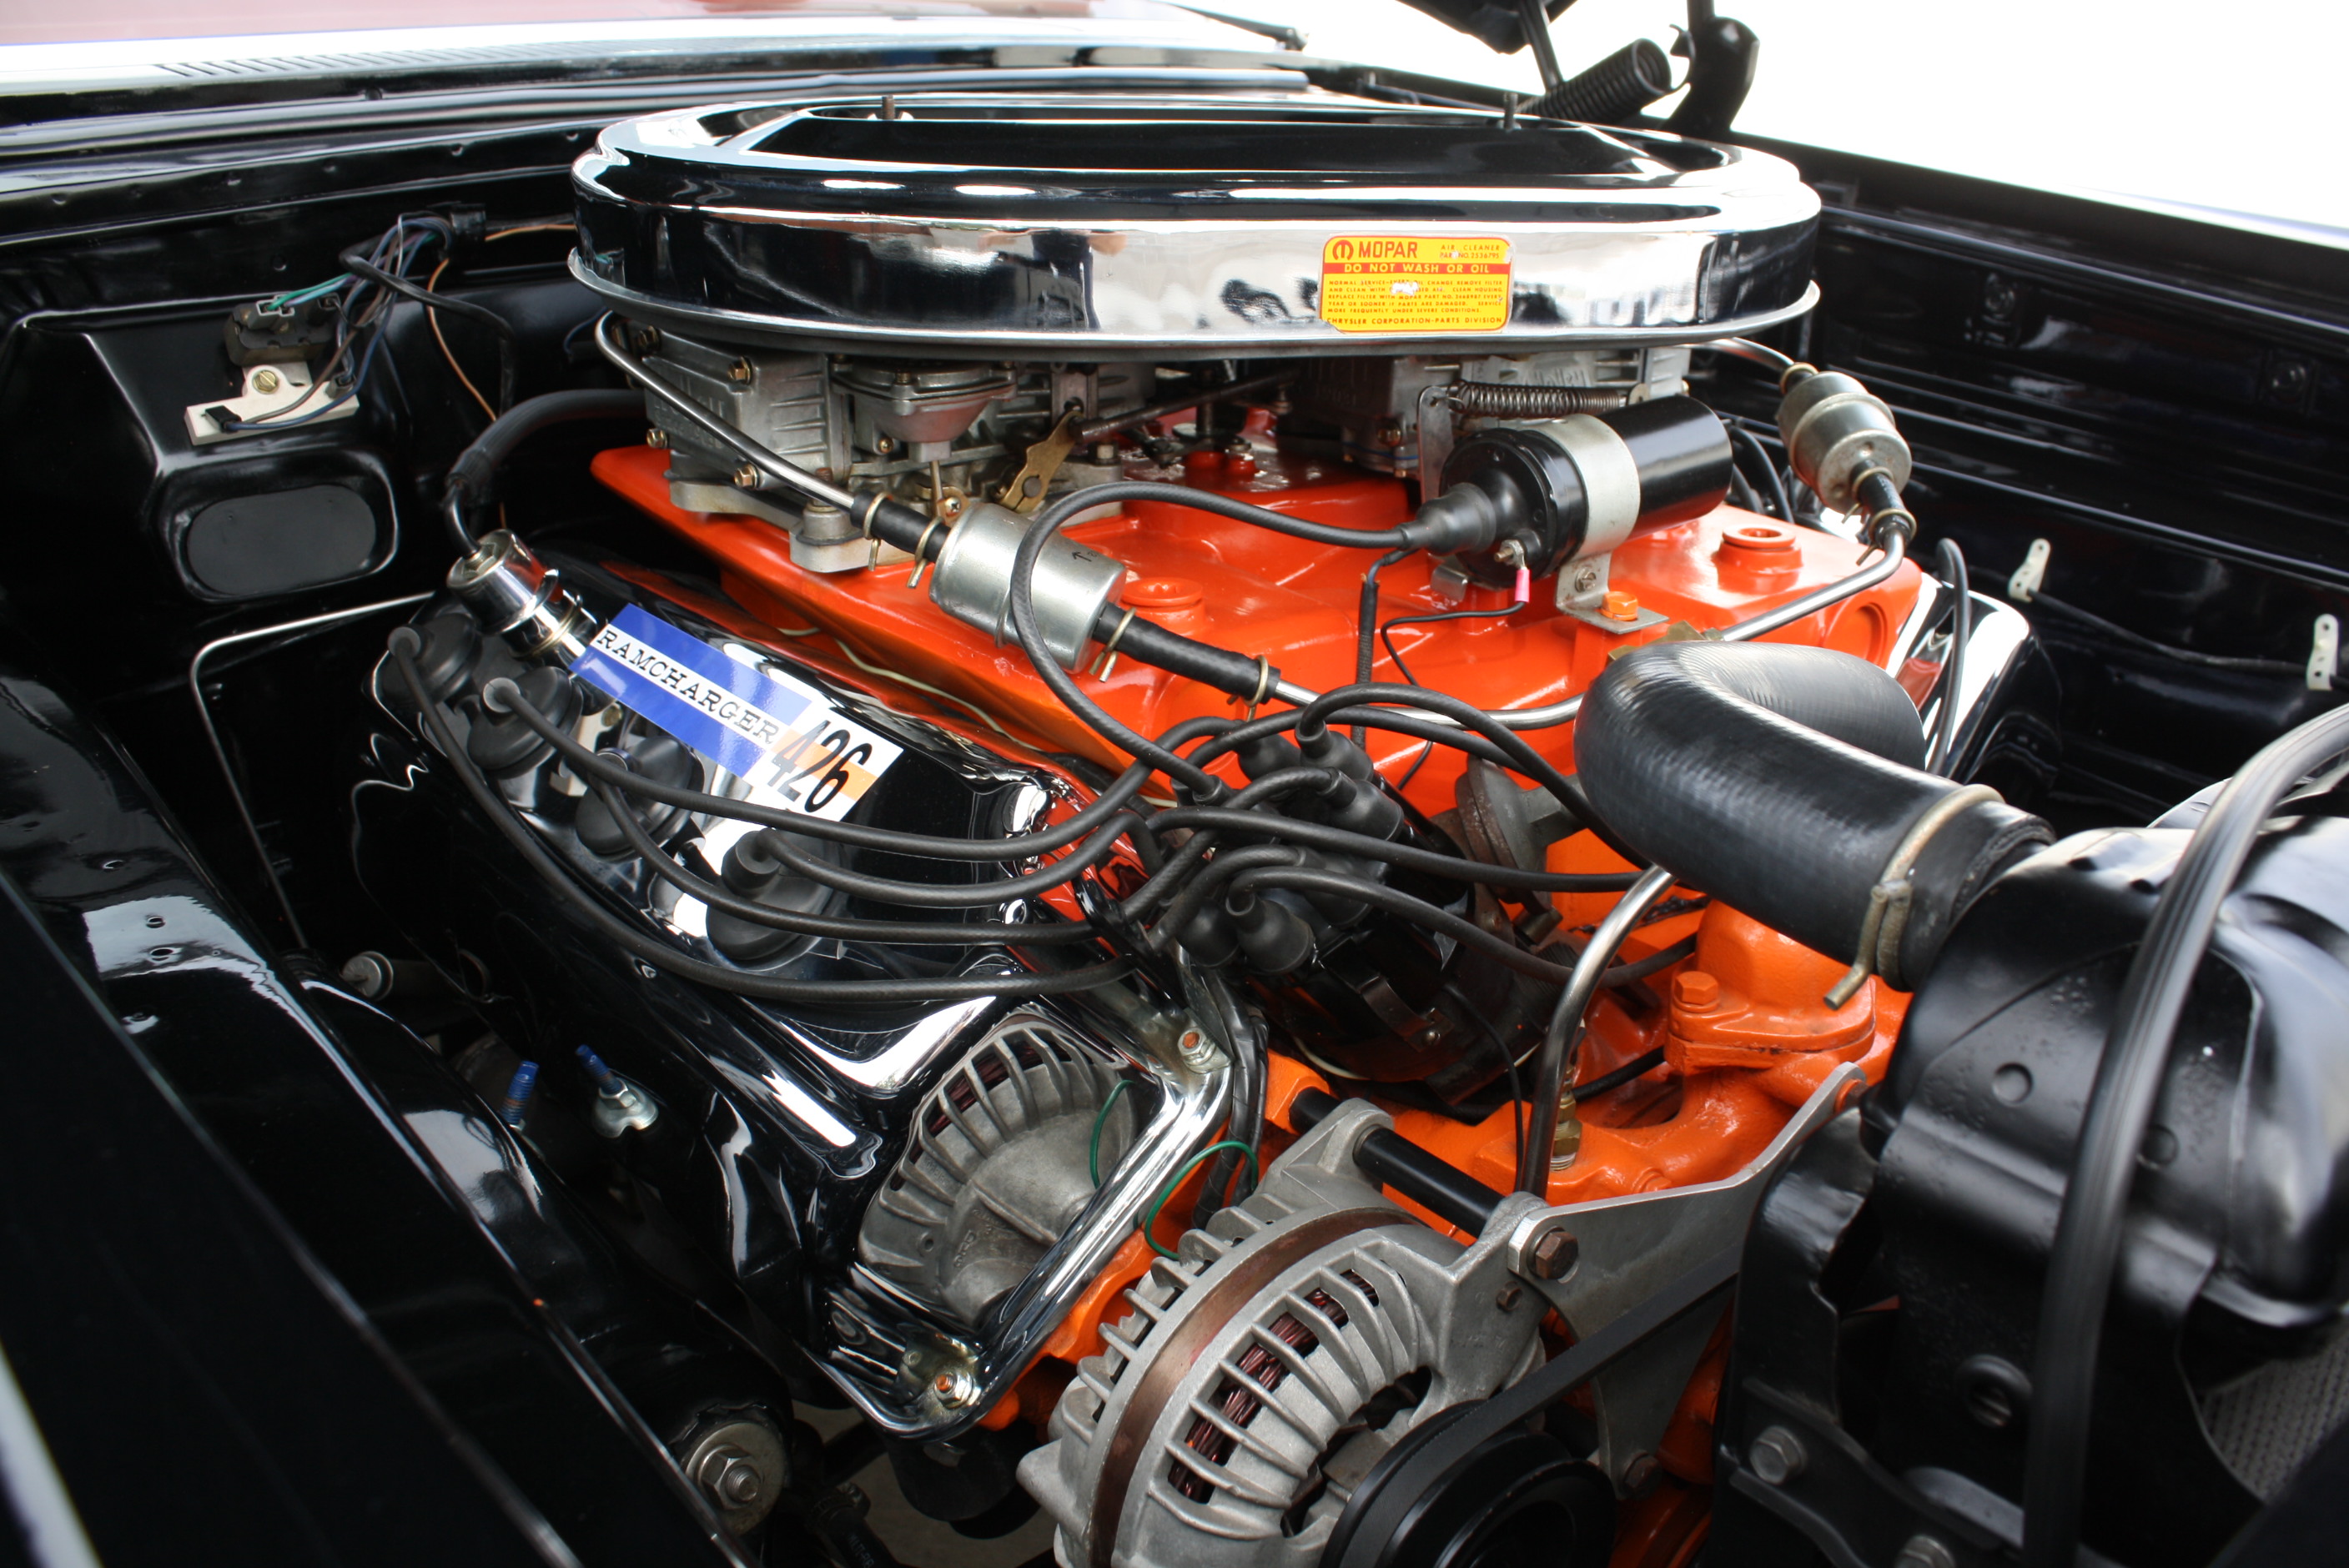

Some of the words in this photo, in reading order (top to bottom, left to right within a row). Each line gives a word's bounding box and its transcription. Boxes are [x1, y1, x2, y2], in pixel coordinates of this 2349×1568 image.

[1344, 264, 1362, 273] DO
[1369, 264, 1396, 273] NOT
[1402, 264, 1439, 273] WASH
[1446, 264, 1463, 273] OR
[1471, 264, 1489, 273] OIL
[1359, 241, 1418, 259] MOPAR
[596, 629, 781, 746] RAMCHARGER
[767, 720, 873, 813] 426
